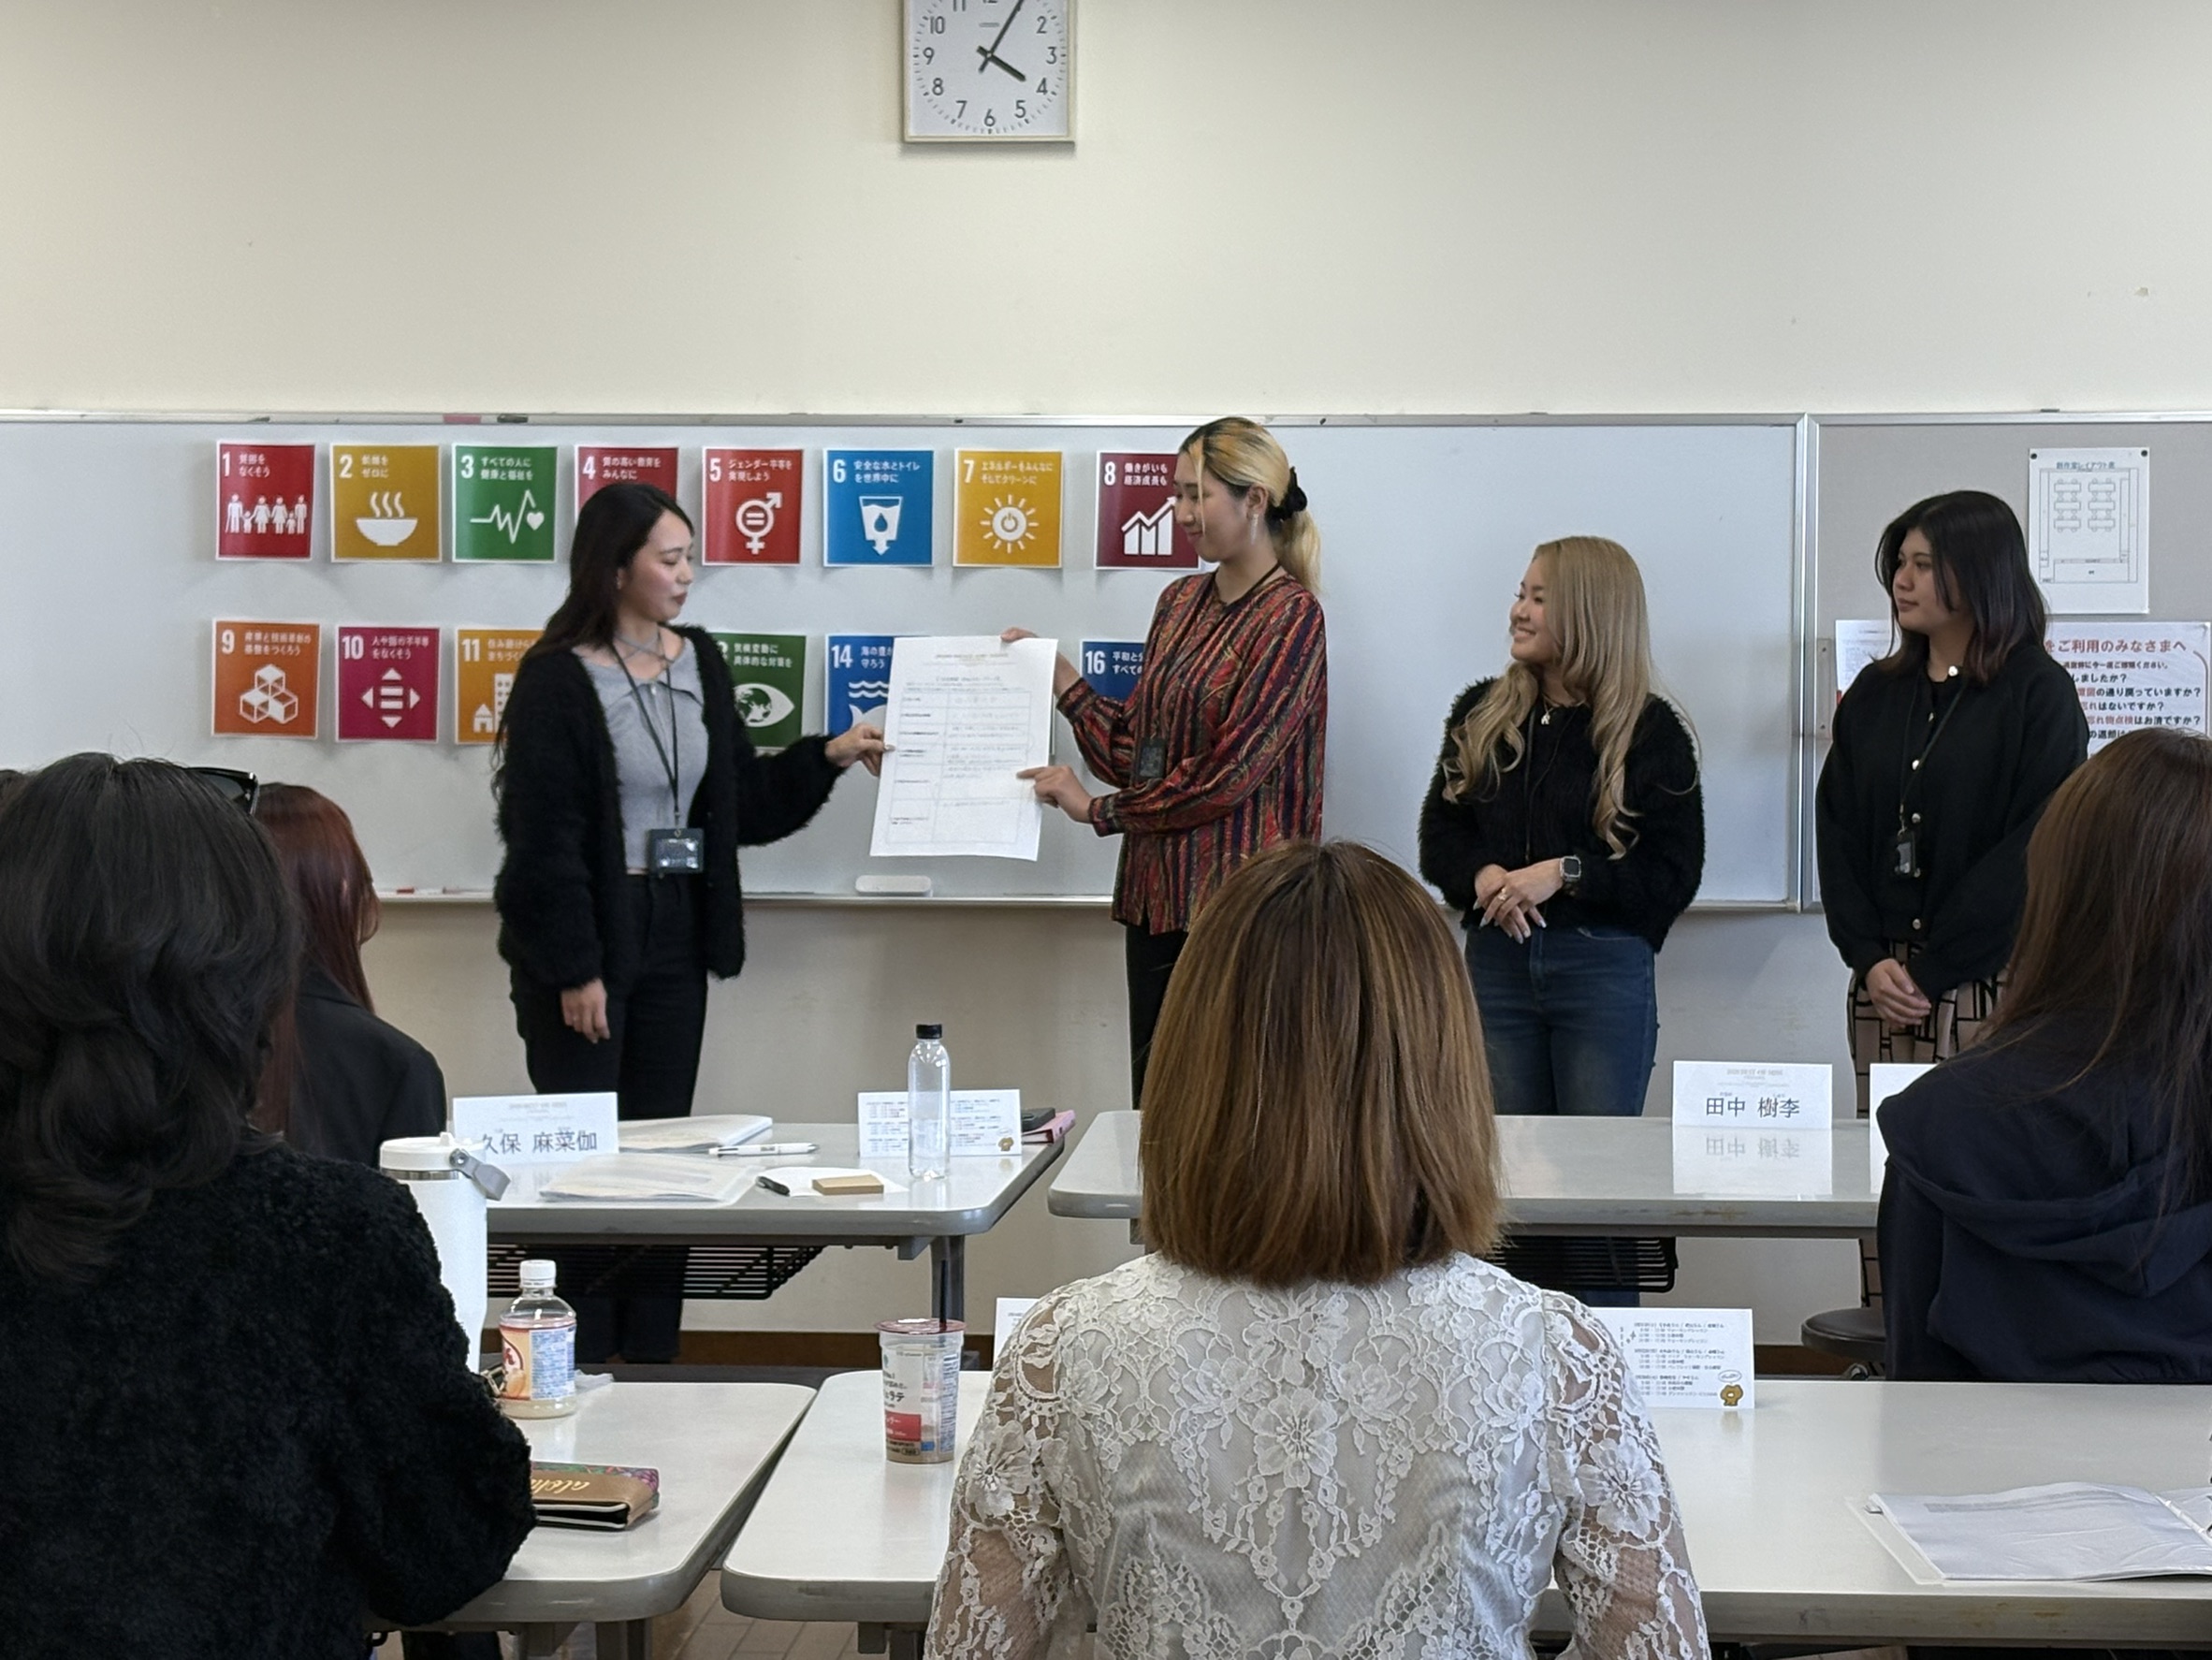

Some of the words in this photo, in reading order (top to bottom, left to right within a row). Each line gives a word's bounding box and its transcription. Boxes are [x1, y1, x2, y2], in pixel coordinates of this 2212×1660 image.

[930, 15, 946, 35] 10
[1036, 15, 1048, 35] 2
[923, 47, 935, 66] 9
[1045, 47, 1057, 66] 3
[932, 78, 944, 96] 8
[1036, 77, 1049, 95] 4
[955, 100, 968, 119] 7
[983, 109, 997, 127] 6
[1014, 100, 1026, 119] 5
[223, 451, 231, 477] 1
[339, 454, 354, 478] 2
[460, 455, 474, 479] 3
[582, 456, 596, 480] 4
[709, 458, 721, 483] 5
[833, 459, 846, 484] 6
[963, 459, 975, 484] 7
[1104, 461, 1116, 486] 8
[222, 629, 235, 655] 9
[342, 634, 364, 660] 10
[461, 638, 480, 663] 11
[831, 644, 853, 669] 14
[1085, 649, 1106, 675] 16
[1706, 1097, 1746, 1118] 田中
[1757, 1097, 1800, 1118] 樹李
[531, 1130, 598, 1154] 麻菜伽
